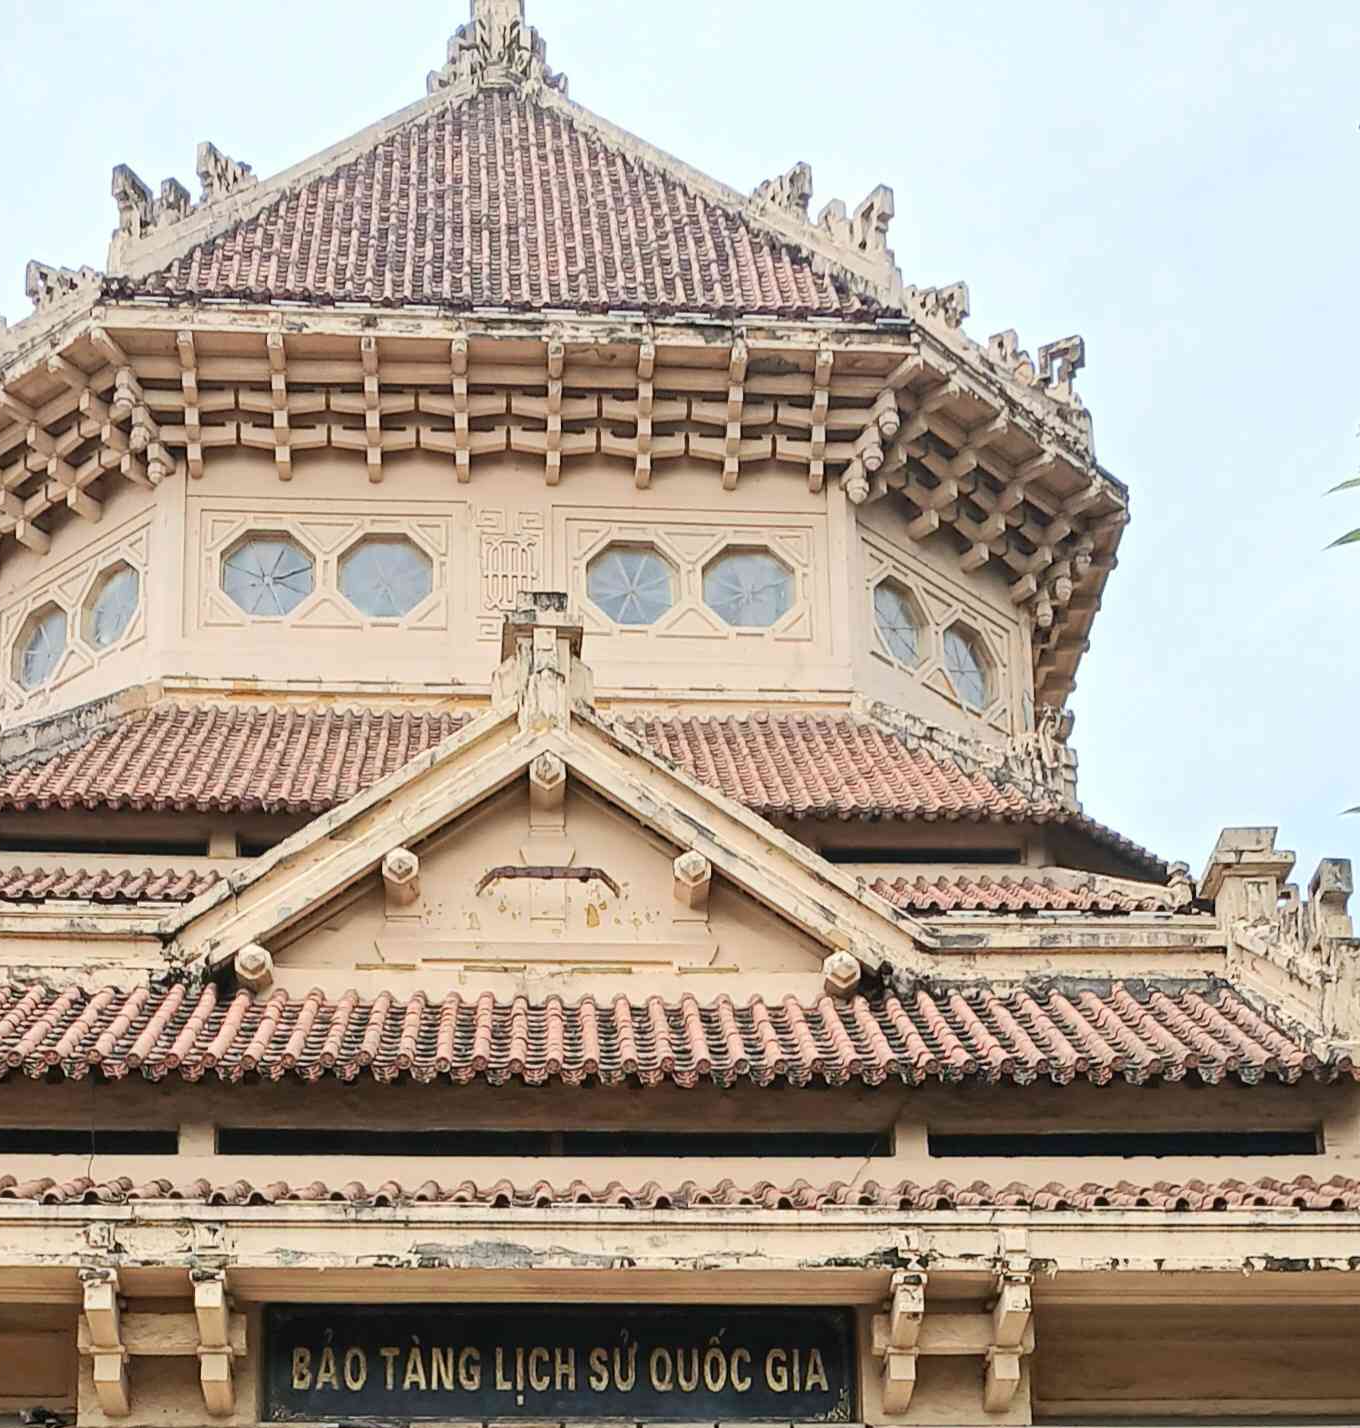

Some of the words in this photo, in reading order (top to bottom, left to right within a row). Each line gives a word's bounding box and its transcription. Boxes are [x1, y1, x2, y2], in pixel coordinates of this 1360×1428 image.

[291, 1328, 368, 1391] BẢO
[380, 1334, 482, 1391] TÀNG
[495, 1347, 577, 1405] LỊCH
[589, 1328, 638, 1393] SỬ
[650, 1328, 753, 1393] QUỐC
[765, 1348, 830, 1393] GIA
